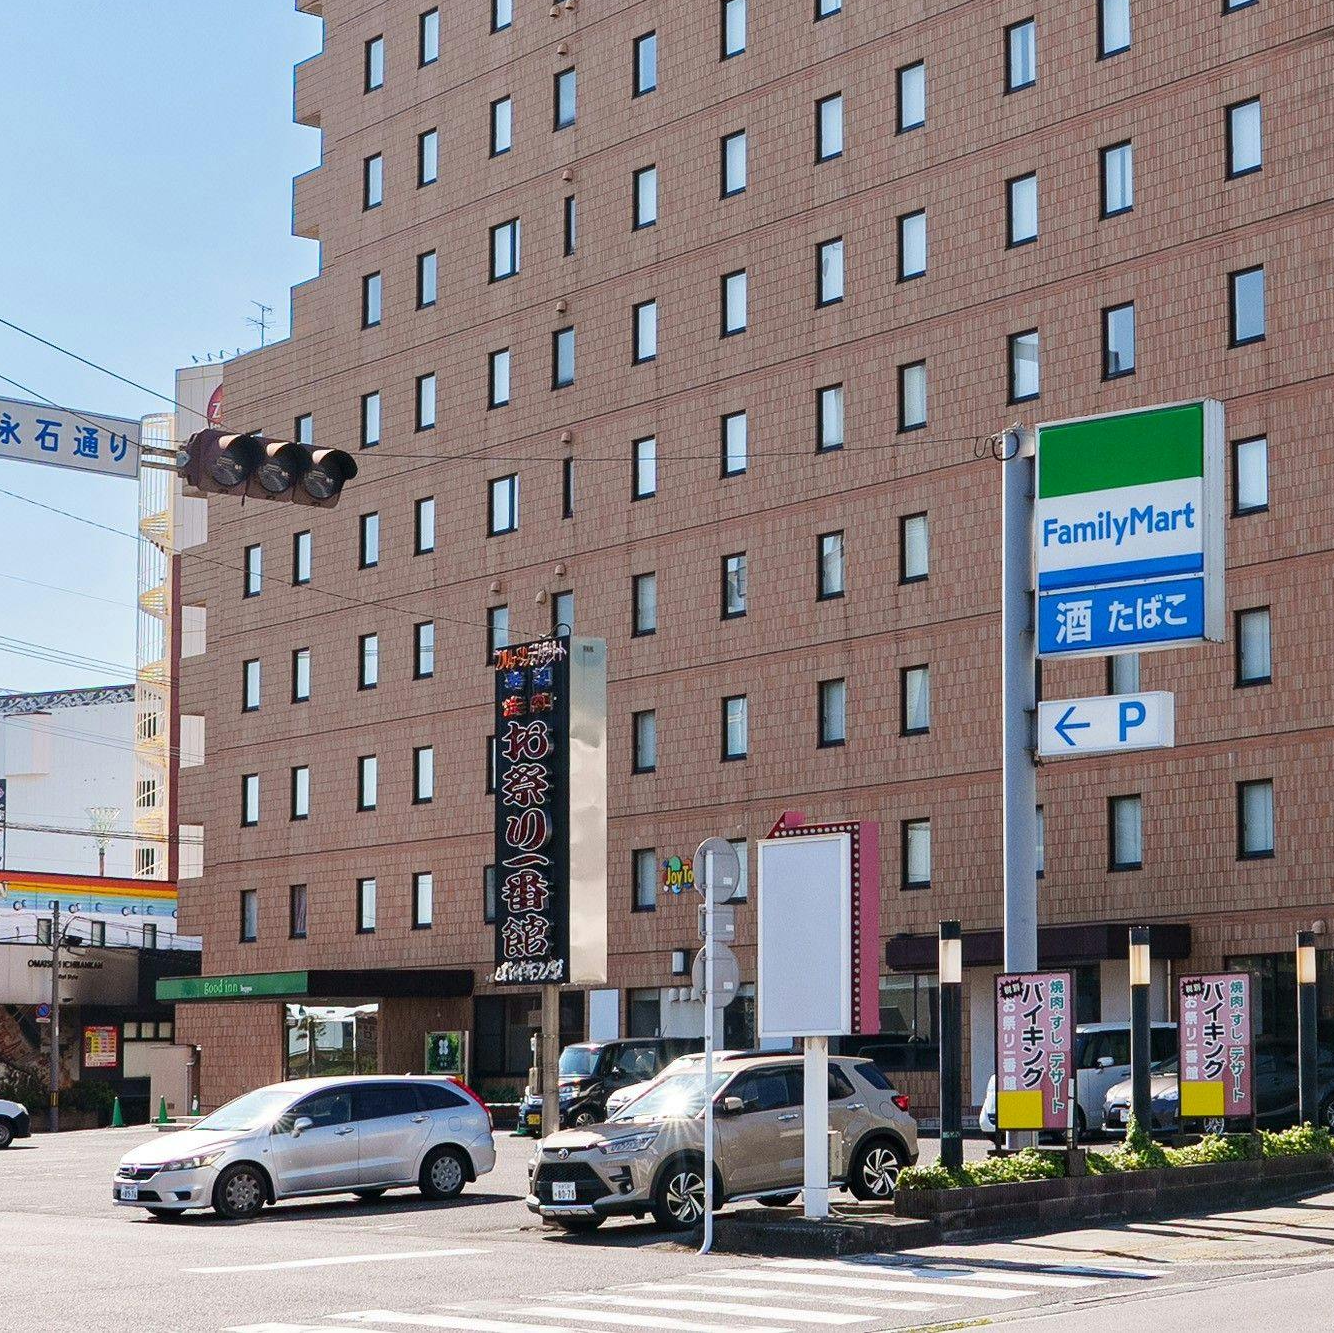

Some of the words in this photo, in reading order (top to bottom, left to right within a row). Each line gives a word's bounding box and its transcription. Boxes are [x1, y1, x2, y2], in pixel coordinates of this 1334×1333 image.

[1043, 502, 1195, 547] FamilyMart
[1055, 599, 1093, 644] 酒
[1108, 593, 1188, 633] たばこ
[1118, 701, 1147, 742] P
[502, 720, 549, 959] お祭り一番館
[204, 979, 223, 995] good
[225, 981, 238, 993] inn
[1022, 981, 1045, 1089] バイキング
[1203, 981, 1225, 1080] バイキング
